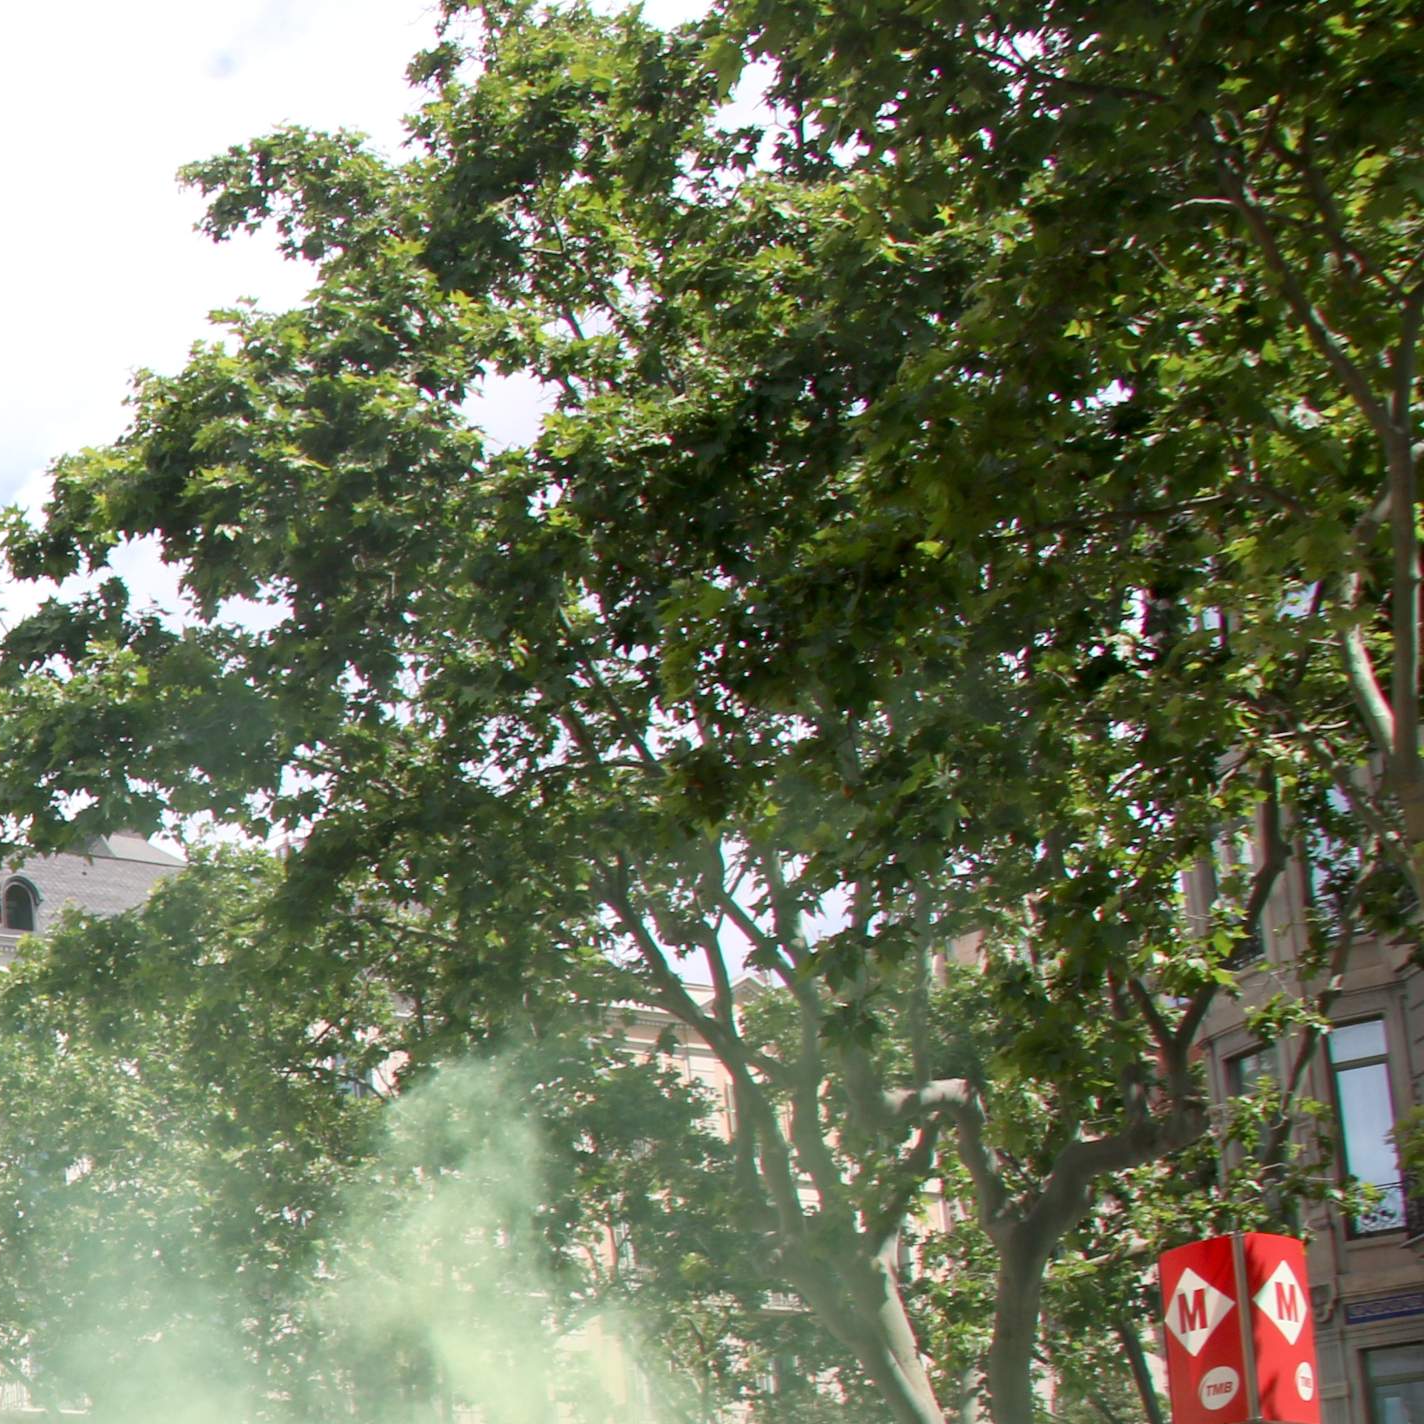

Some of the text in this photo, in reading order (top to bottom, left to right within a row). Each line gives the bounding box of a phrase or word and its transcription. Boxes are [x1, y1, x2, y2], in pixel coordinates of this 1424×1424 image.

[1177, 1289, 1209, 1334] M
[1274, 1281, 1299, 1323] M
[1206, 1381, 1233, 1397] TMB
